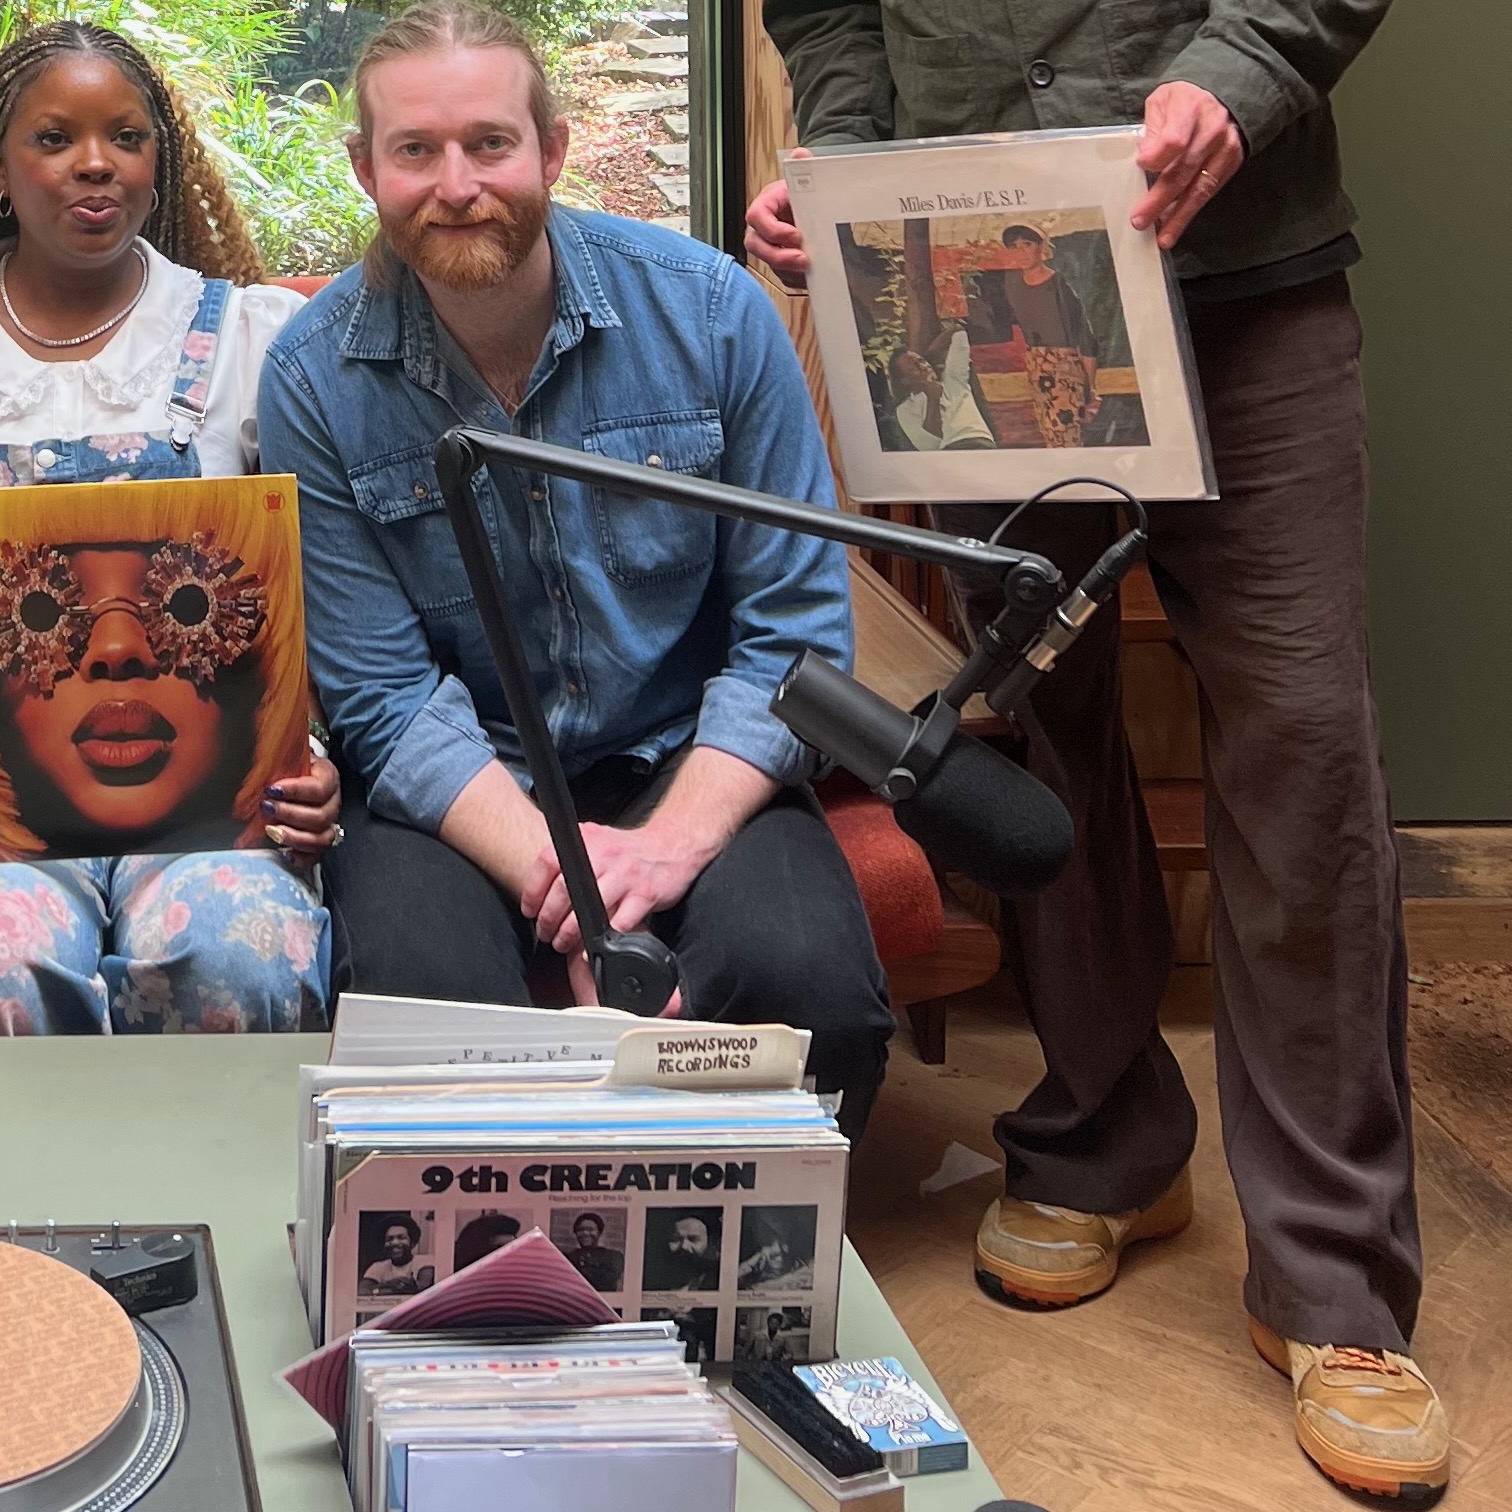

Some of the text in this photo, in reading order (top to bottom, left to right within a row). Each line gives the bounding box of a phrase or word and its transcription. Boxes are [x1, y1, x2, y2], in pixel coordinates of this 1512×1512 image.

[899, 195, 934, 213] Miles
[657, 1037, 758, 1054] BROWNSWOOD
[657, 1054, 751, 1074] RECORDINGS
[421, 1162, 757, 1195] 9th CREATION
[811, 1359, 902, 1388] BICYCLE
